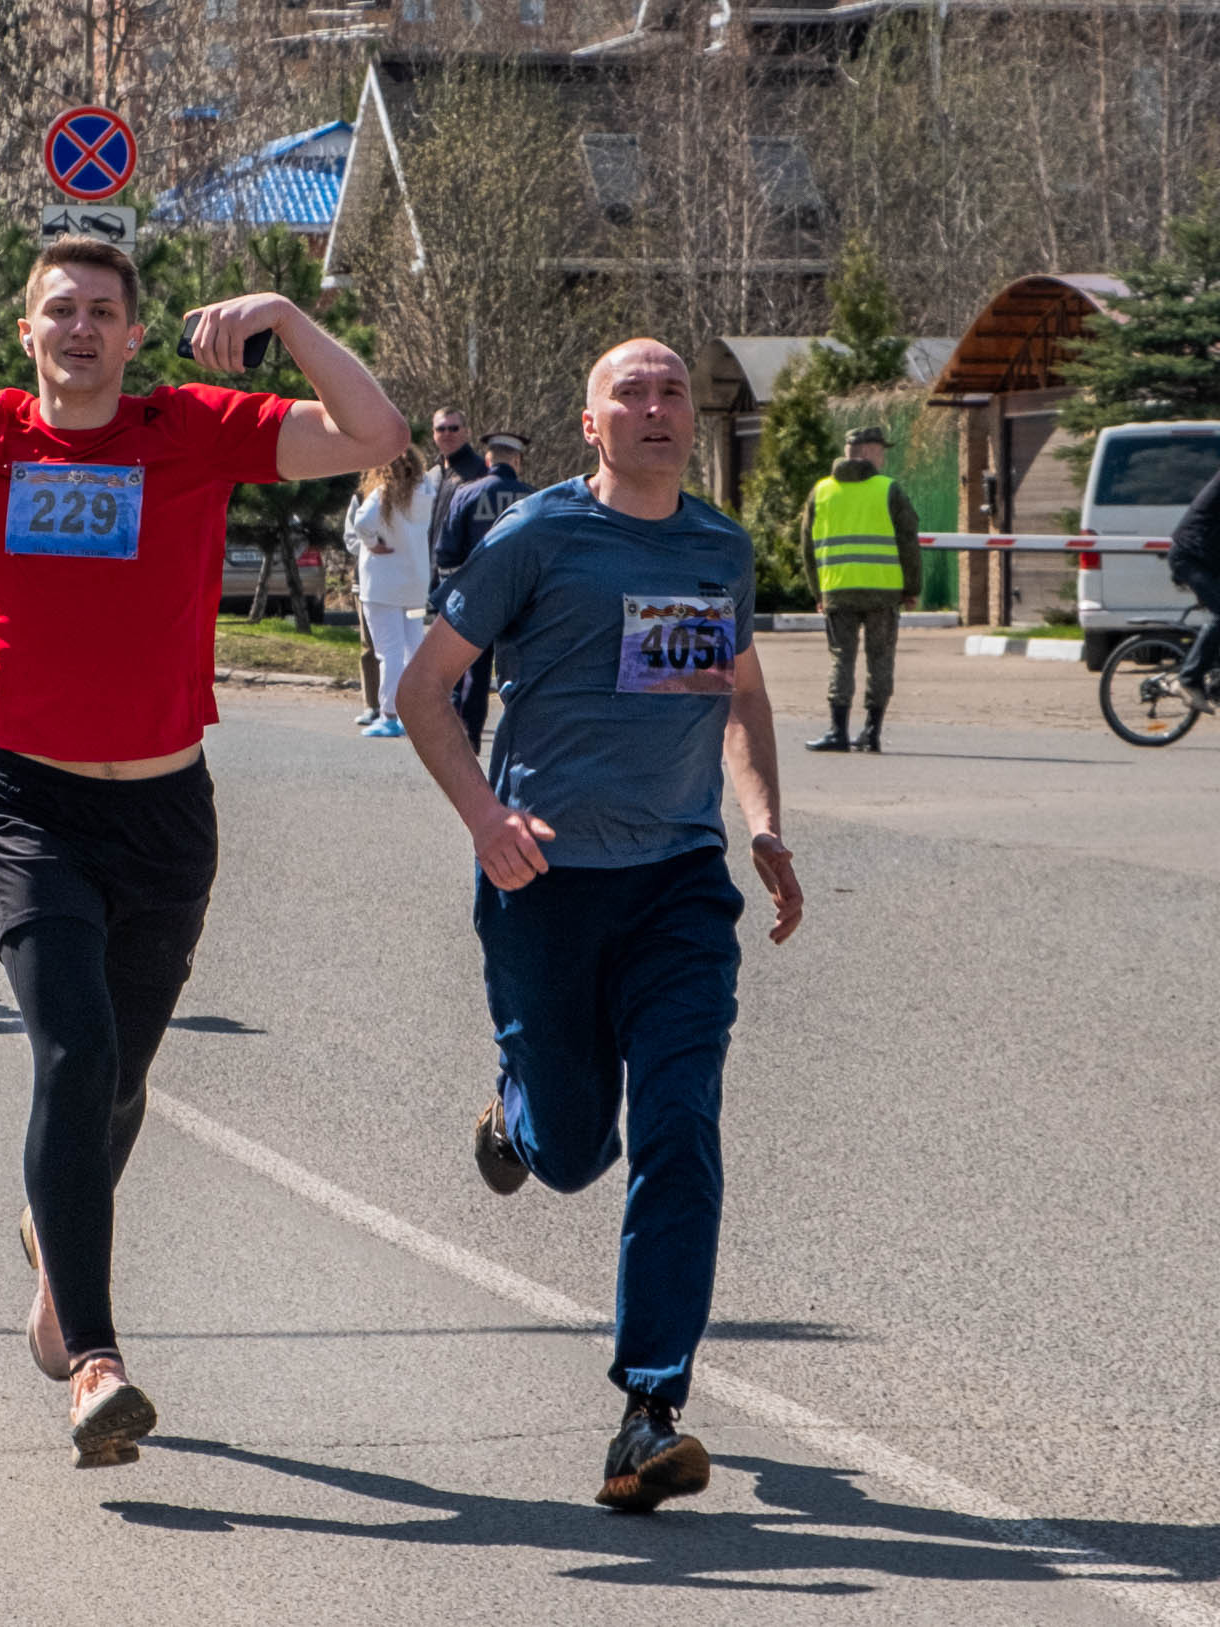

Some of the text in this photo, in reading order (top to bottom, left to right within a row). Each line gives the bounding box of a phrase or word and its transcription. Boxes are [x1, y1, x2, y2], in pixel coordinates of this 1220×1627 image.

[29, 489, 117, 535] 229
[473, 490, 533, 520] ДП
[641, 624, 716, 669] 405
